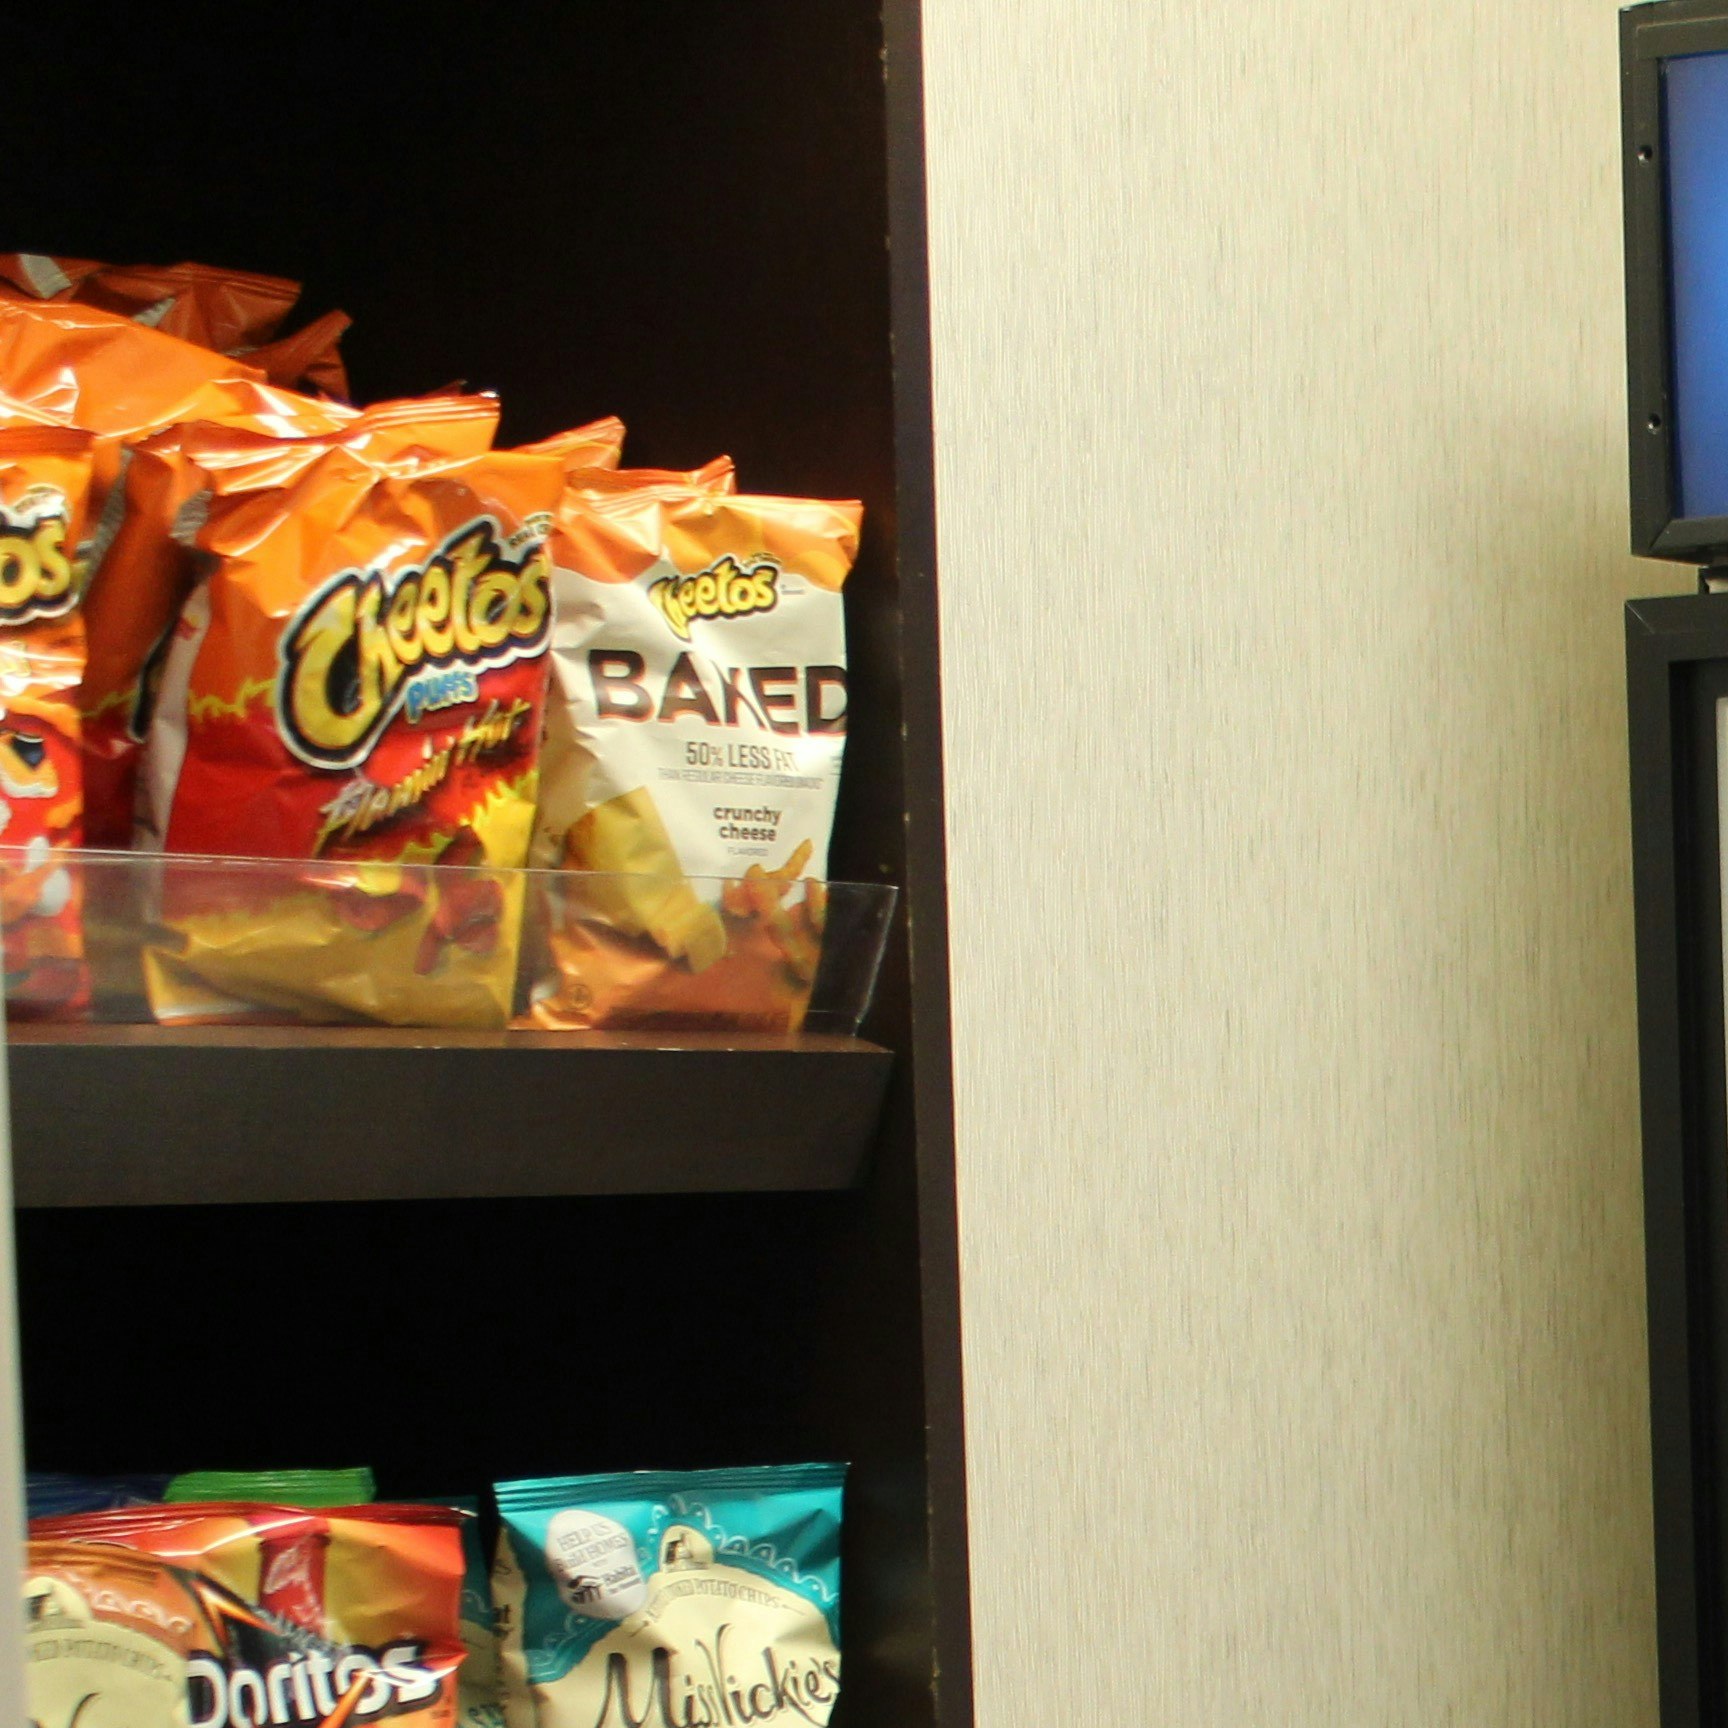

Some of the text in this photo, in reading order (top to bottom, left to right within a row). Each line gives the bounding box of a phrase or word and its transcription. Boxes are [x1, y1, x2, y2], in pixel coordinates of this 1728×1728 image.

[288, 525, 551, 756] Cheetos
[588, 650, 848, 738] BAKED
[686, 742, 724, 767] 50%
[729, 744, 771, 769] LESS
[713, 806, 781, 826] crunchy
[719, 824, 776, 841] cheese
